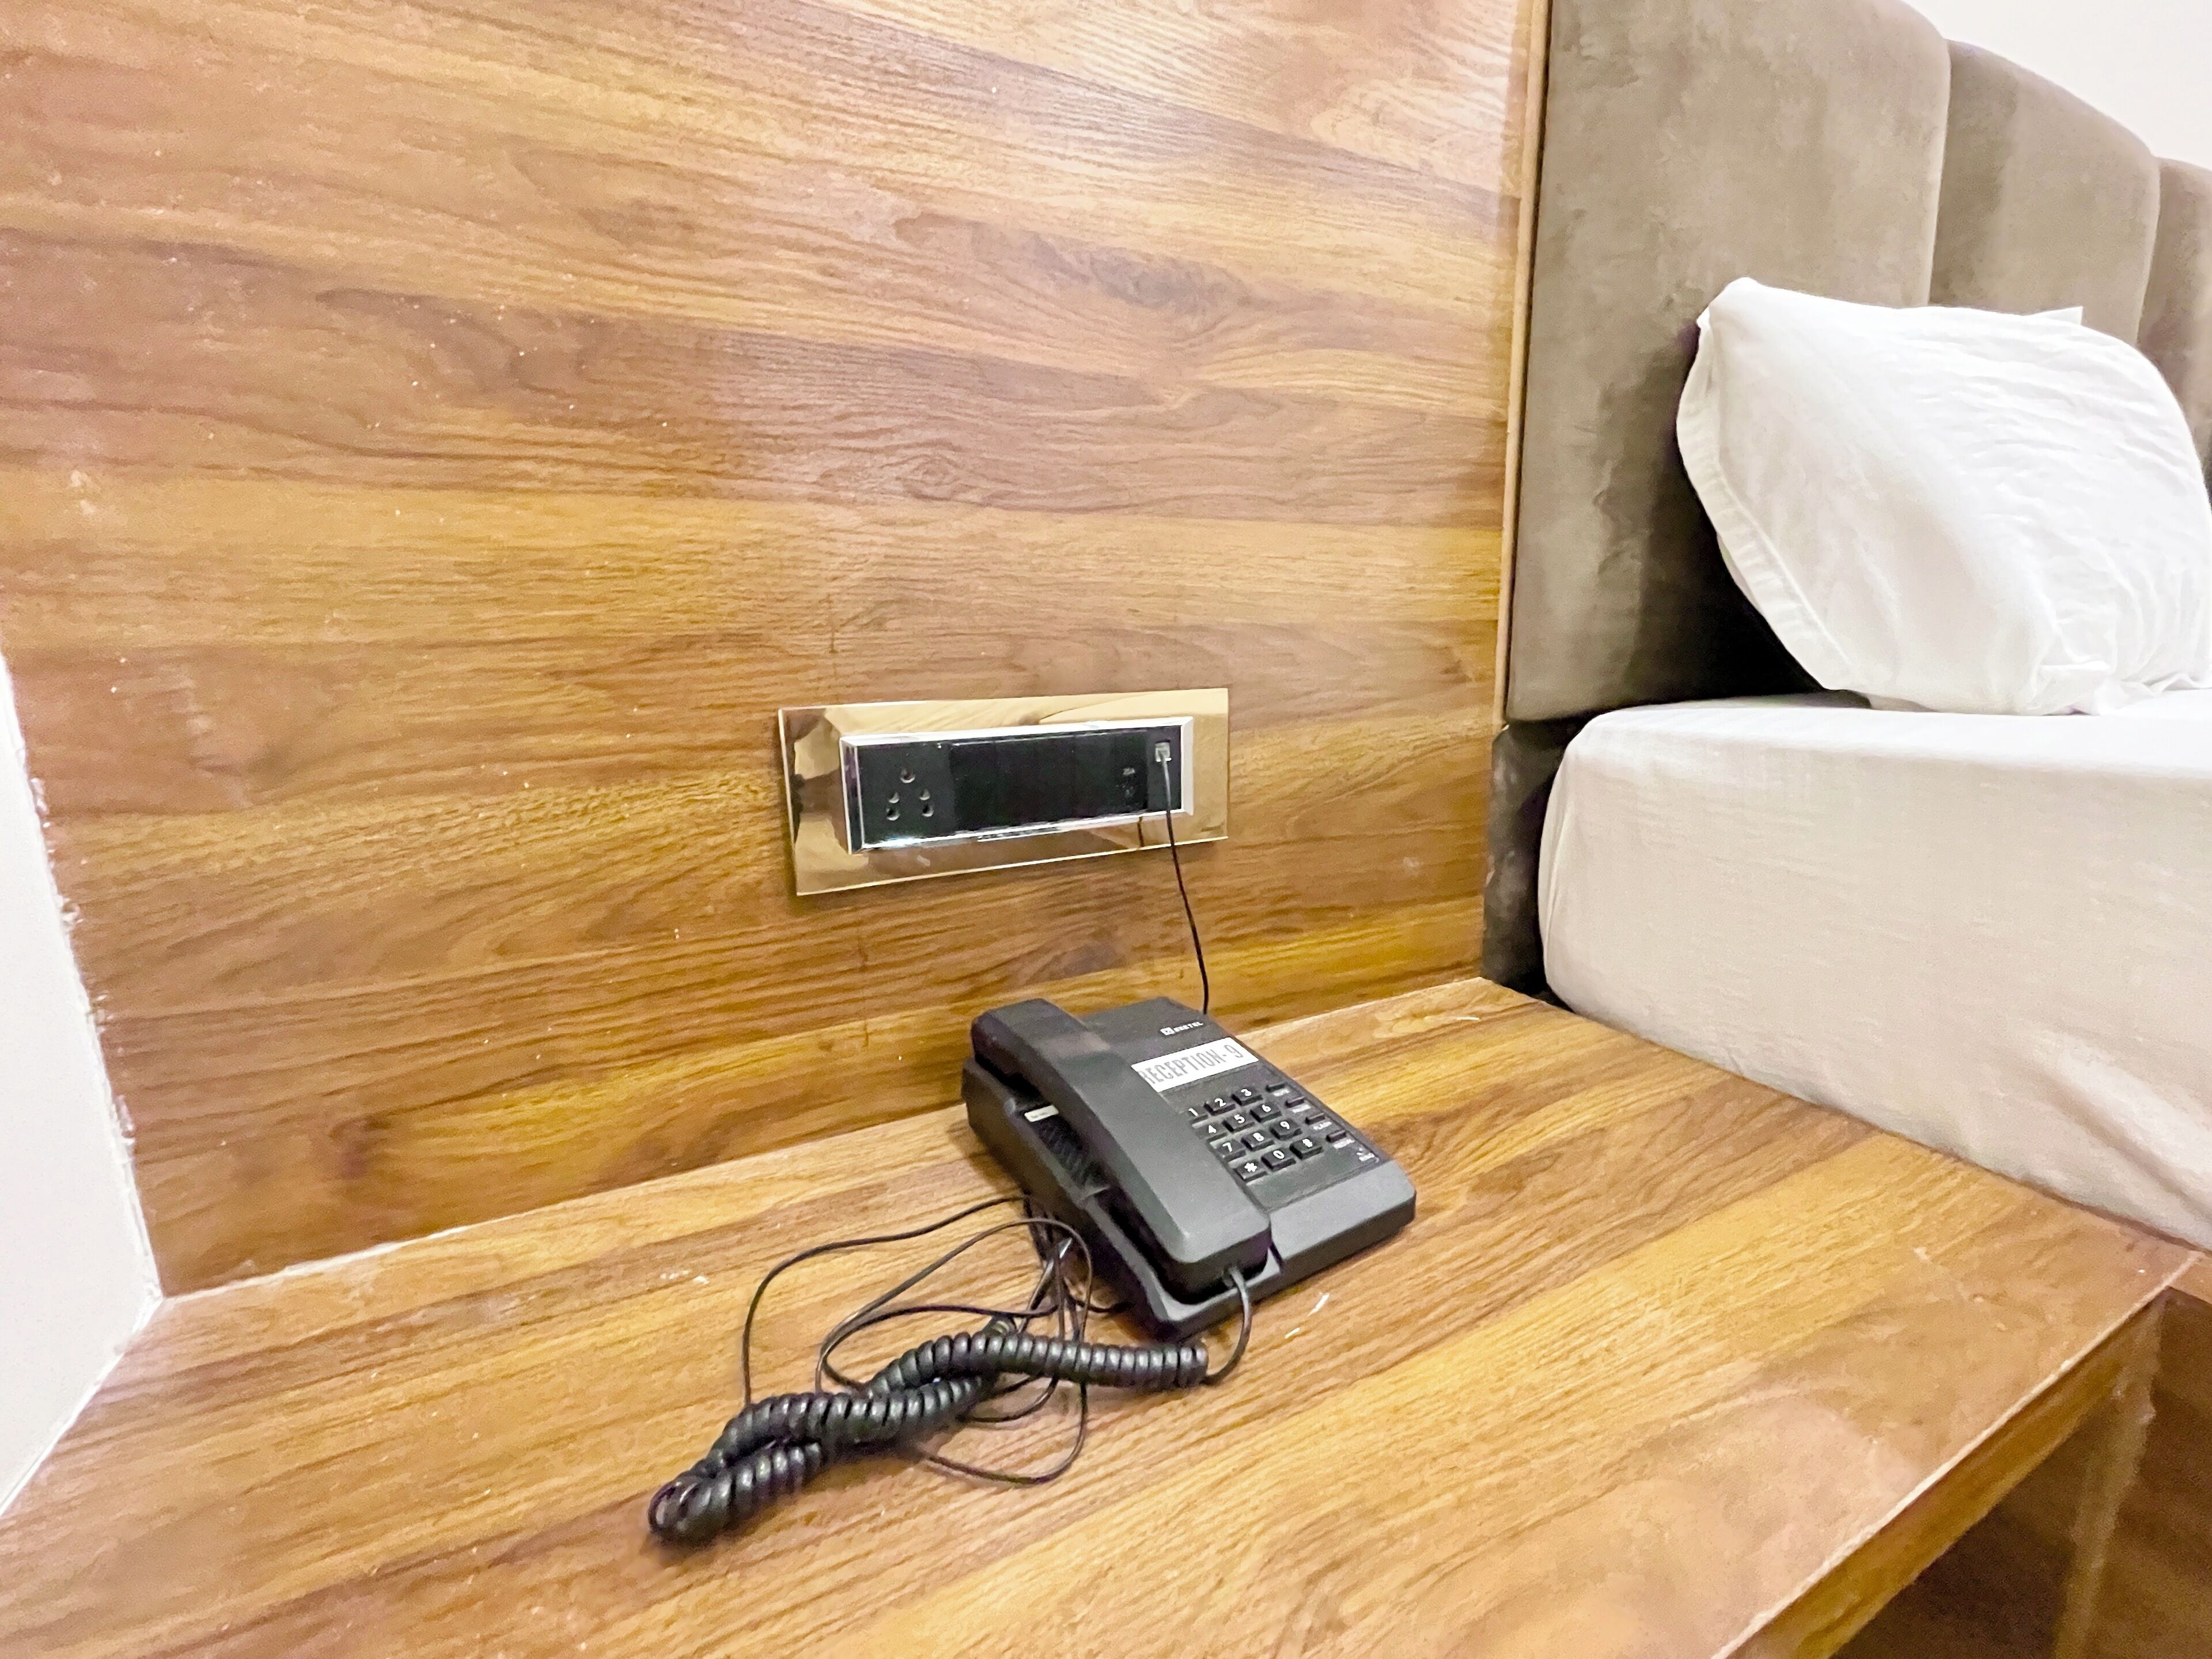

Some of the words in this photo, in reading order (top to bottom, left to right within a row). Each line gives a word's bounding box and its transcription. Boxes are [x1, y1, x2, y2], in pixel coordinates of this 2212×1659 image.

[1188, 1108, 1198, 1116] 1
[1214, 1098, 1226, 1107] 2
[1241, 1089, 1252, 1097] 3
[1208, 1125, 1217, 1133] 4
[1234, 1114, 1245, 1123] 5
[1262, 1104, 1271, 1112] 6
[1222, 1142, 1232, 1152] 7
[1253, 1132, 1264, 1142] 8
[1280, 1121, 1290, 1129] 9
[1273, 1150, 1285, 1159] 0
